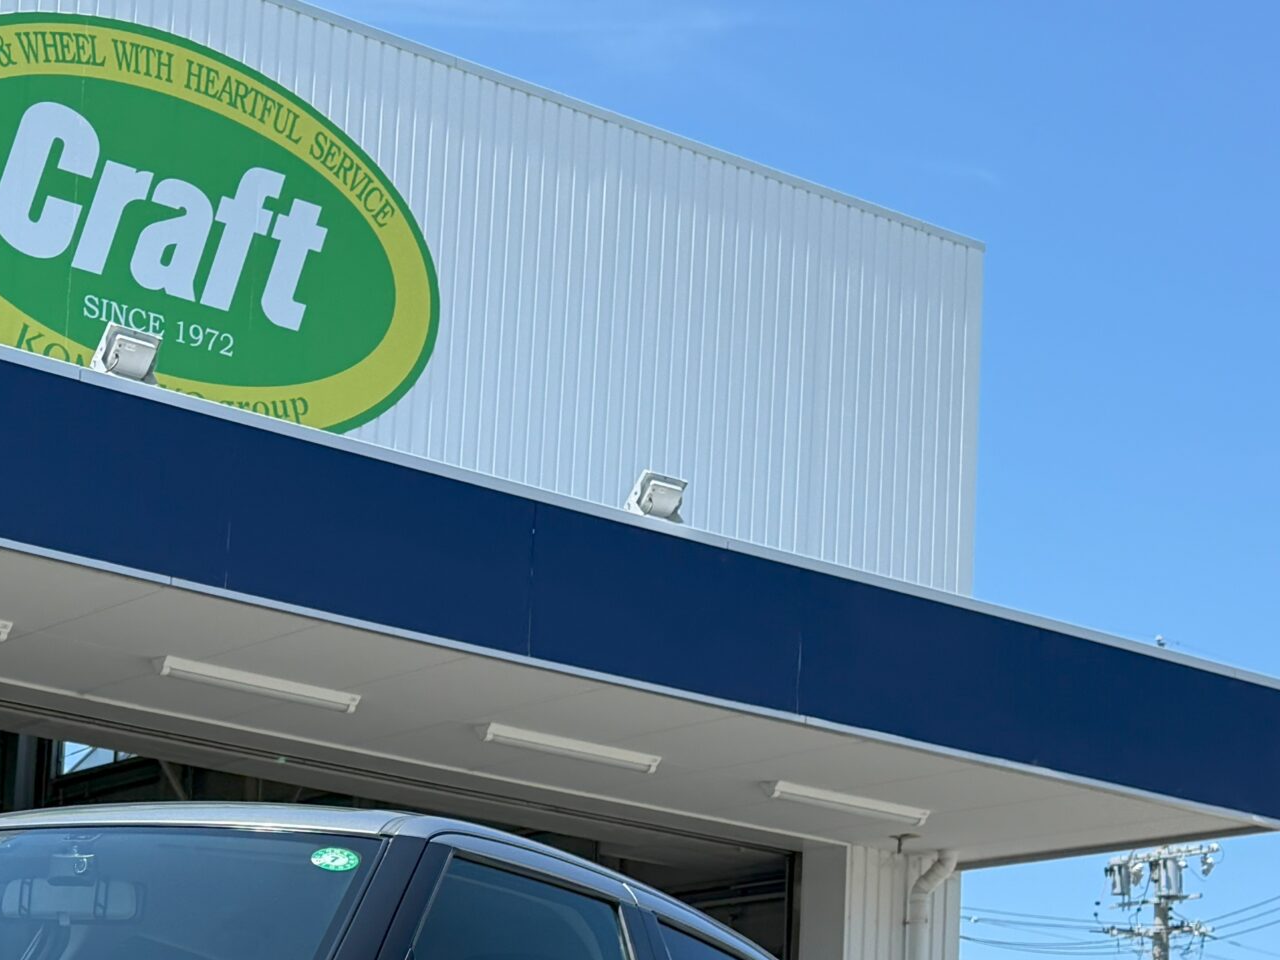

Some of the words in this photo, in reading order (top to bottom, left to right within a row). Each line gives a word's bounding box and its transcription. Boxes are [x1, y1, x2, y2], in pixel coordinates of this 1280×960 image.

[14, 31, 107, 68] WHEEL
[111, 38, 175, 84] WITH
[184, 58, 303, 145] HEARTFUL
[308, 130, 396, 228] SERVICE
[82, 295, 166, 339] SINCE
[175, 320, 235, 358] 1972
